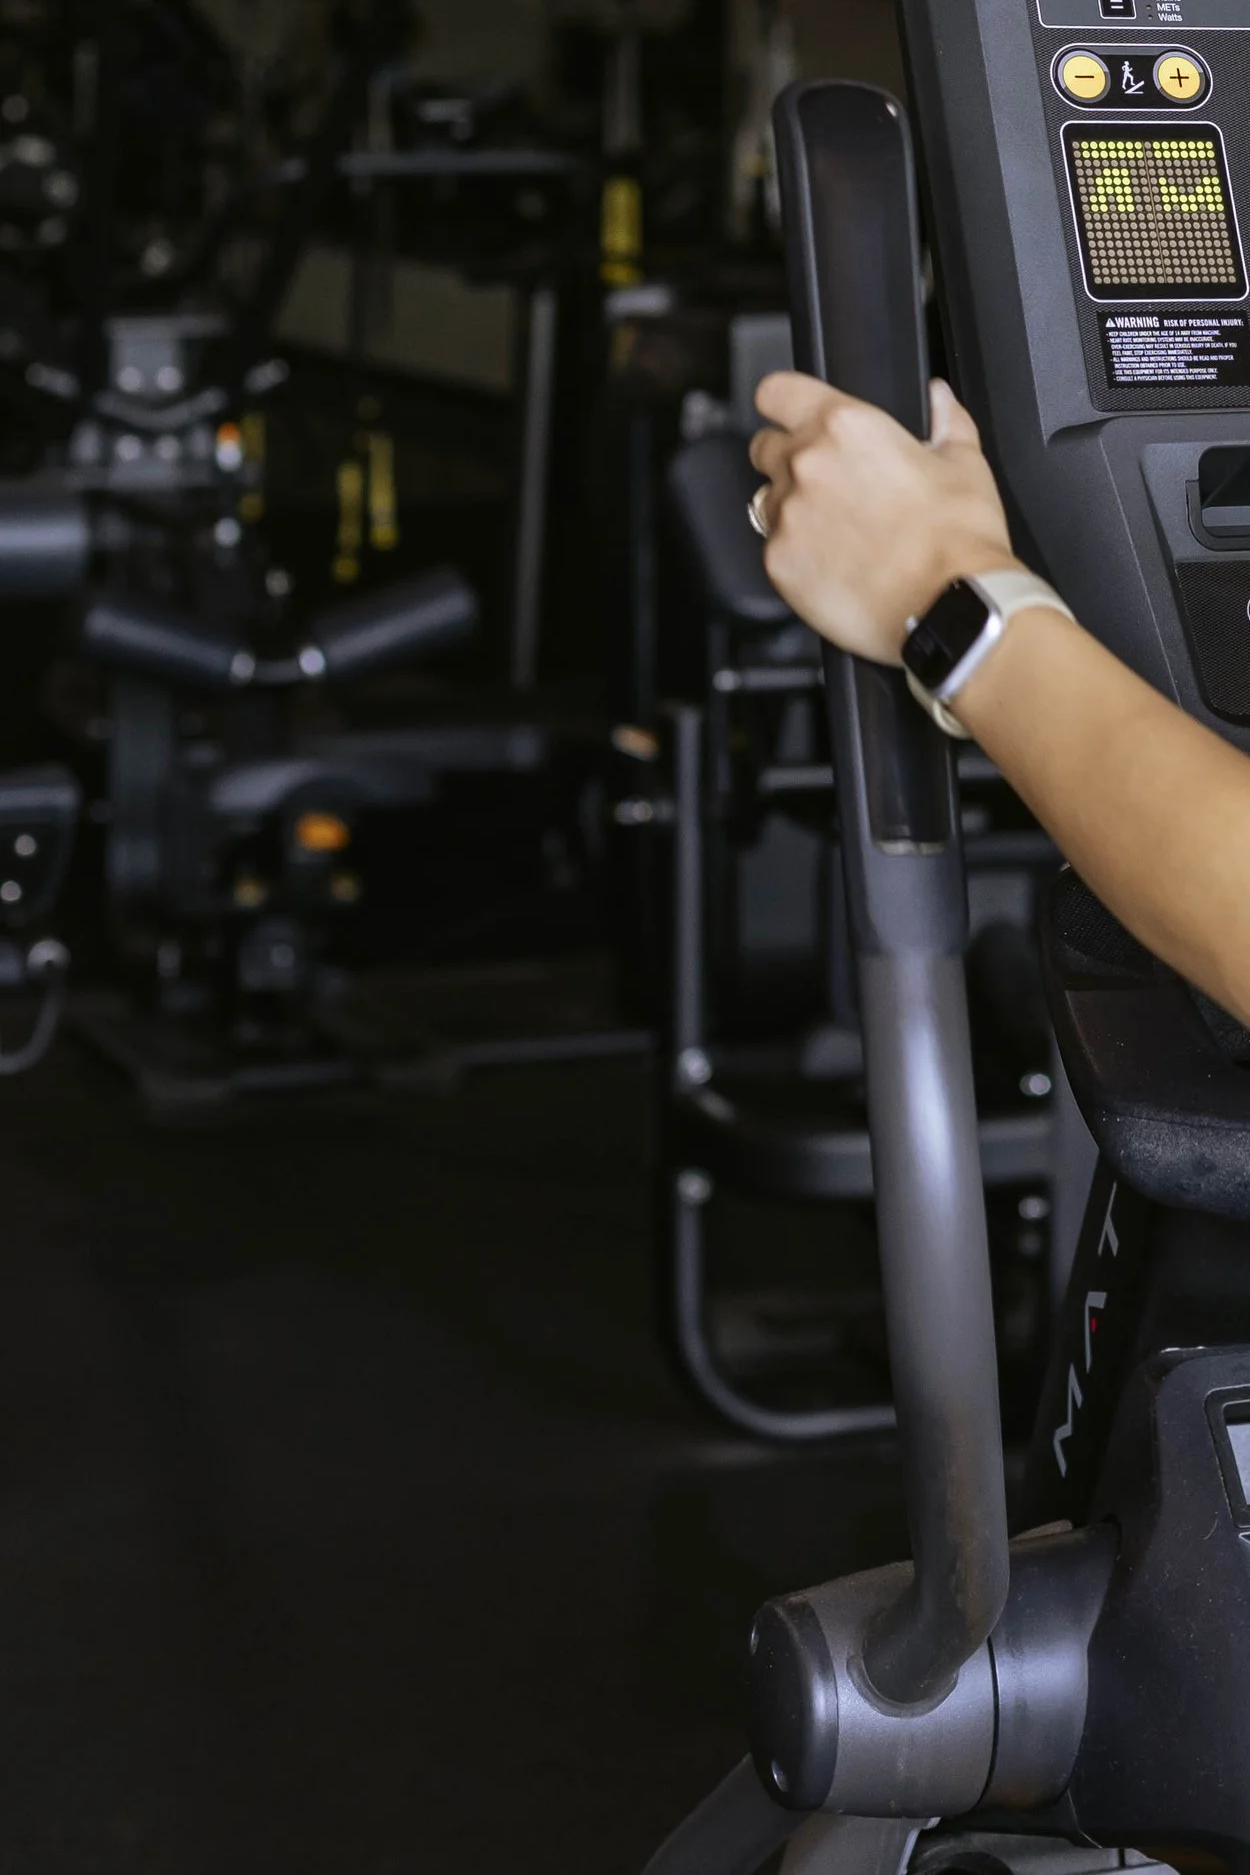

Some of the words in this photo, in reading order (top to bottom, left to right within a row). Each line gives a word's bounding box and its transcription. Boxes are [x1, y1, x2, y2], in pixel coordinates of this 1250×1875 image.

[1157, 4, 1180, 12] METs
[1158, 13, 1182, 22] Watts
[1115, 317, 1160, 328] WARNING
[1164, 319, 1179, 327] RISK
